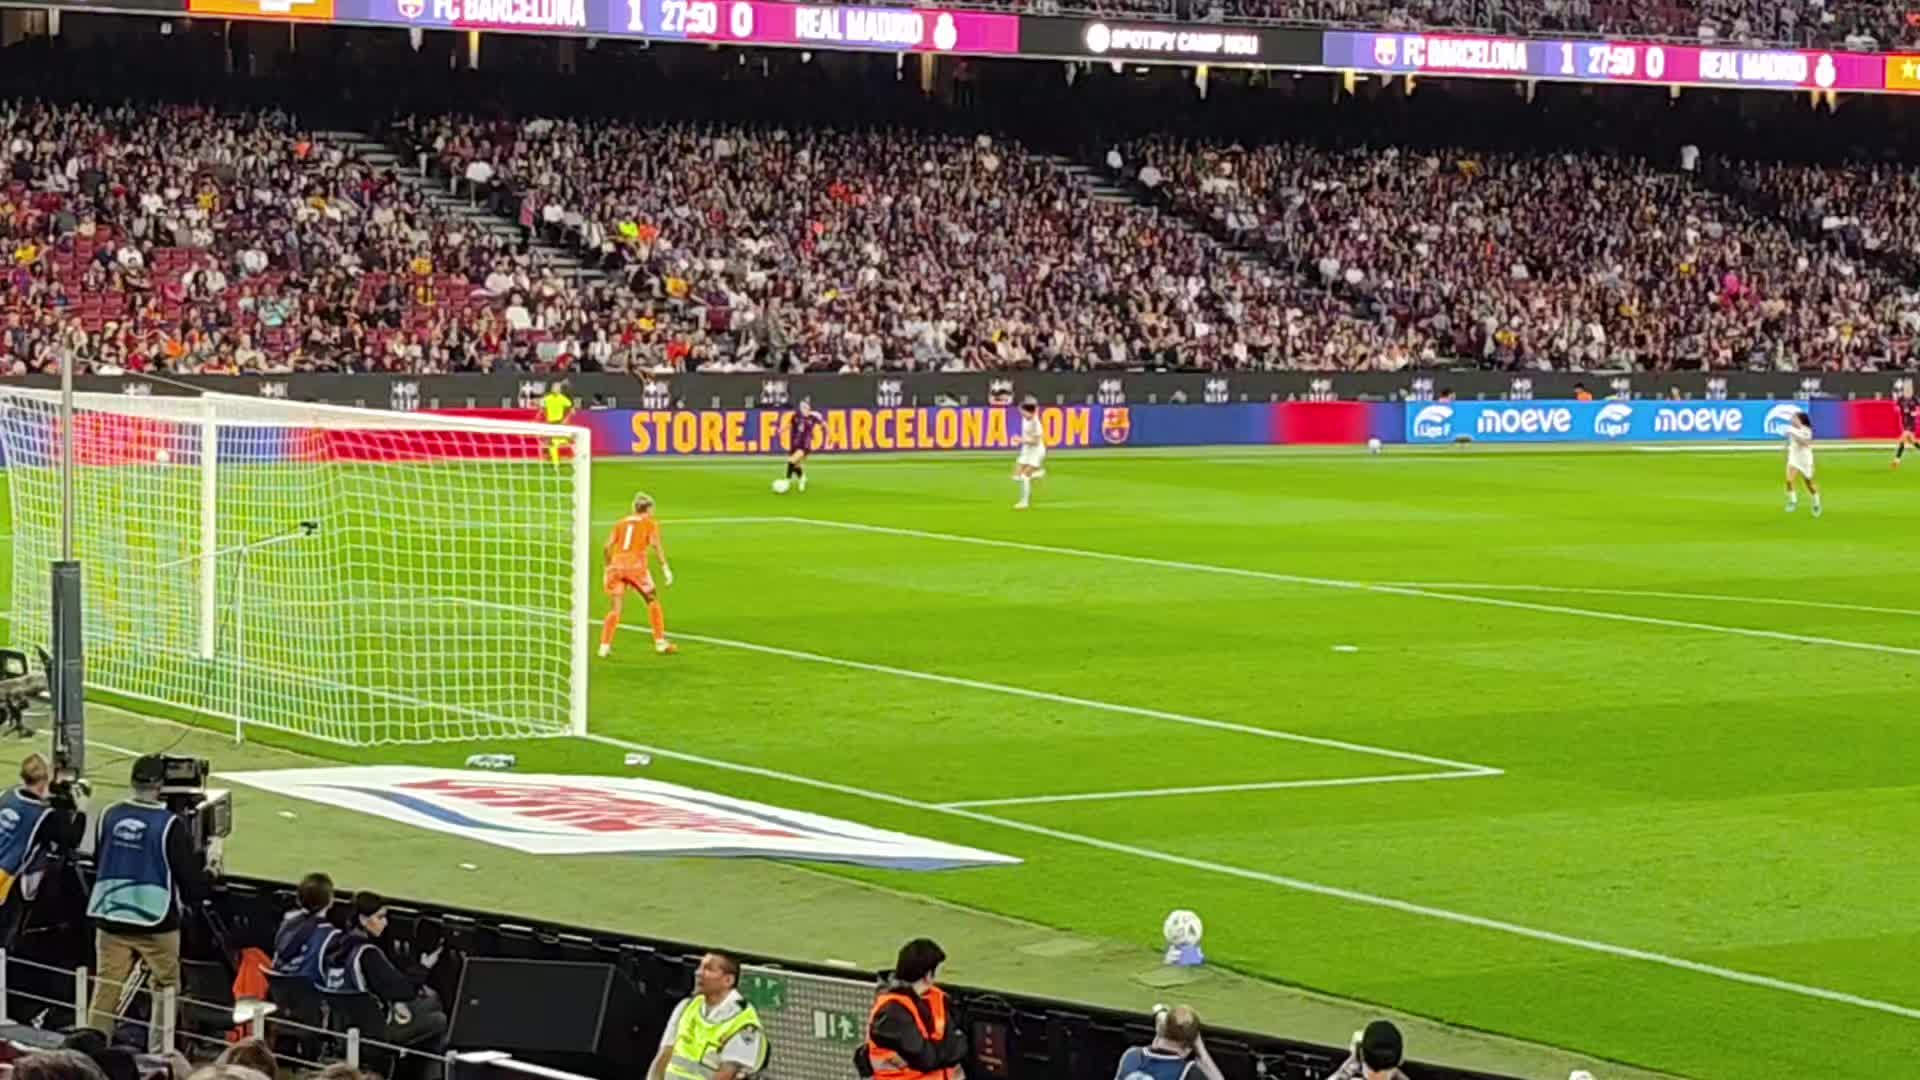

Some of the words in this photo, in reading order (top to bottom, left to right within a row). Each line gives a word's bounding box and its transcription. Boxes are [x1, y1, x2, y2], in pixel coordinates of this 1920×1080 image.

[433, 0, 461, 20] FC
[463, 0, 585, 26] BARCELONA
[628, 0, 644, 31] 1
[661, 1, 717, 34] 27:50
[731, 2, 752, 37] 0
[796, 8, 842, 39] REAL
[846, 11, 923, 44] MADRID
[1111, 29, 1176, 51] SPOTIFY
[1177, 32, 1222, 52] CAMP
[1224, 35, 1258, 54] NOU
[1403, 38, 1425, 66] FC
[1428, 39, 1527, 71] BARCELONA
[1561, 43, 1574, 74] 1
[1588, 46, 1635, 76] 27:50
[1645, 47, 1664, 78] 0
[1700, 50, 1739, 80] REAL
[1742, 52, 1807, 82] MADRID
[631, 408, 1090, 454] STORE.FCARCELONA.OM
[1477, 407, 1571, 433] moeve
[1654, 407, 1742, 432] moeve
[623, 523, 633, 551] 1
